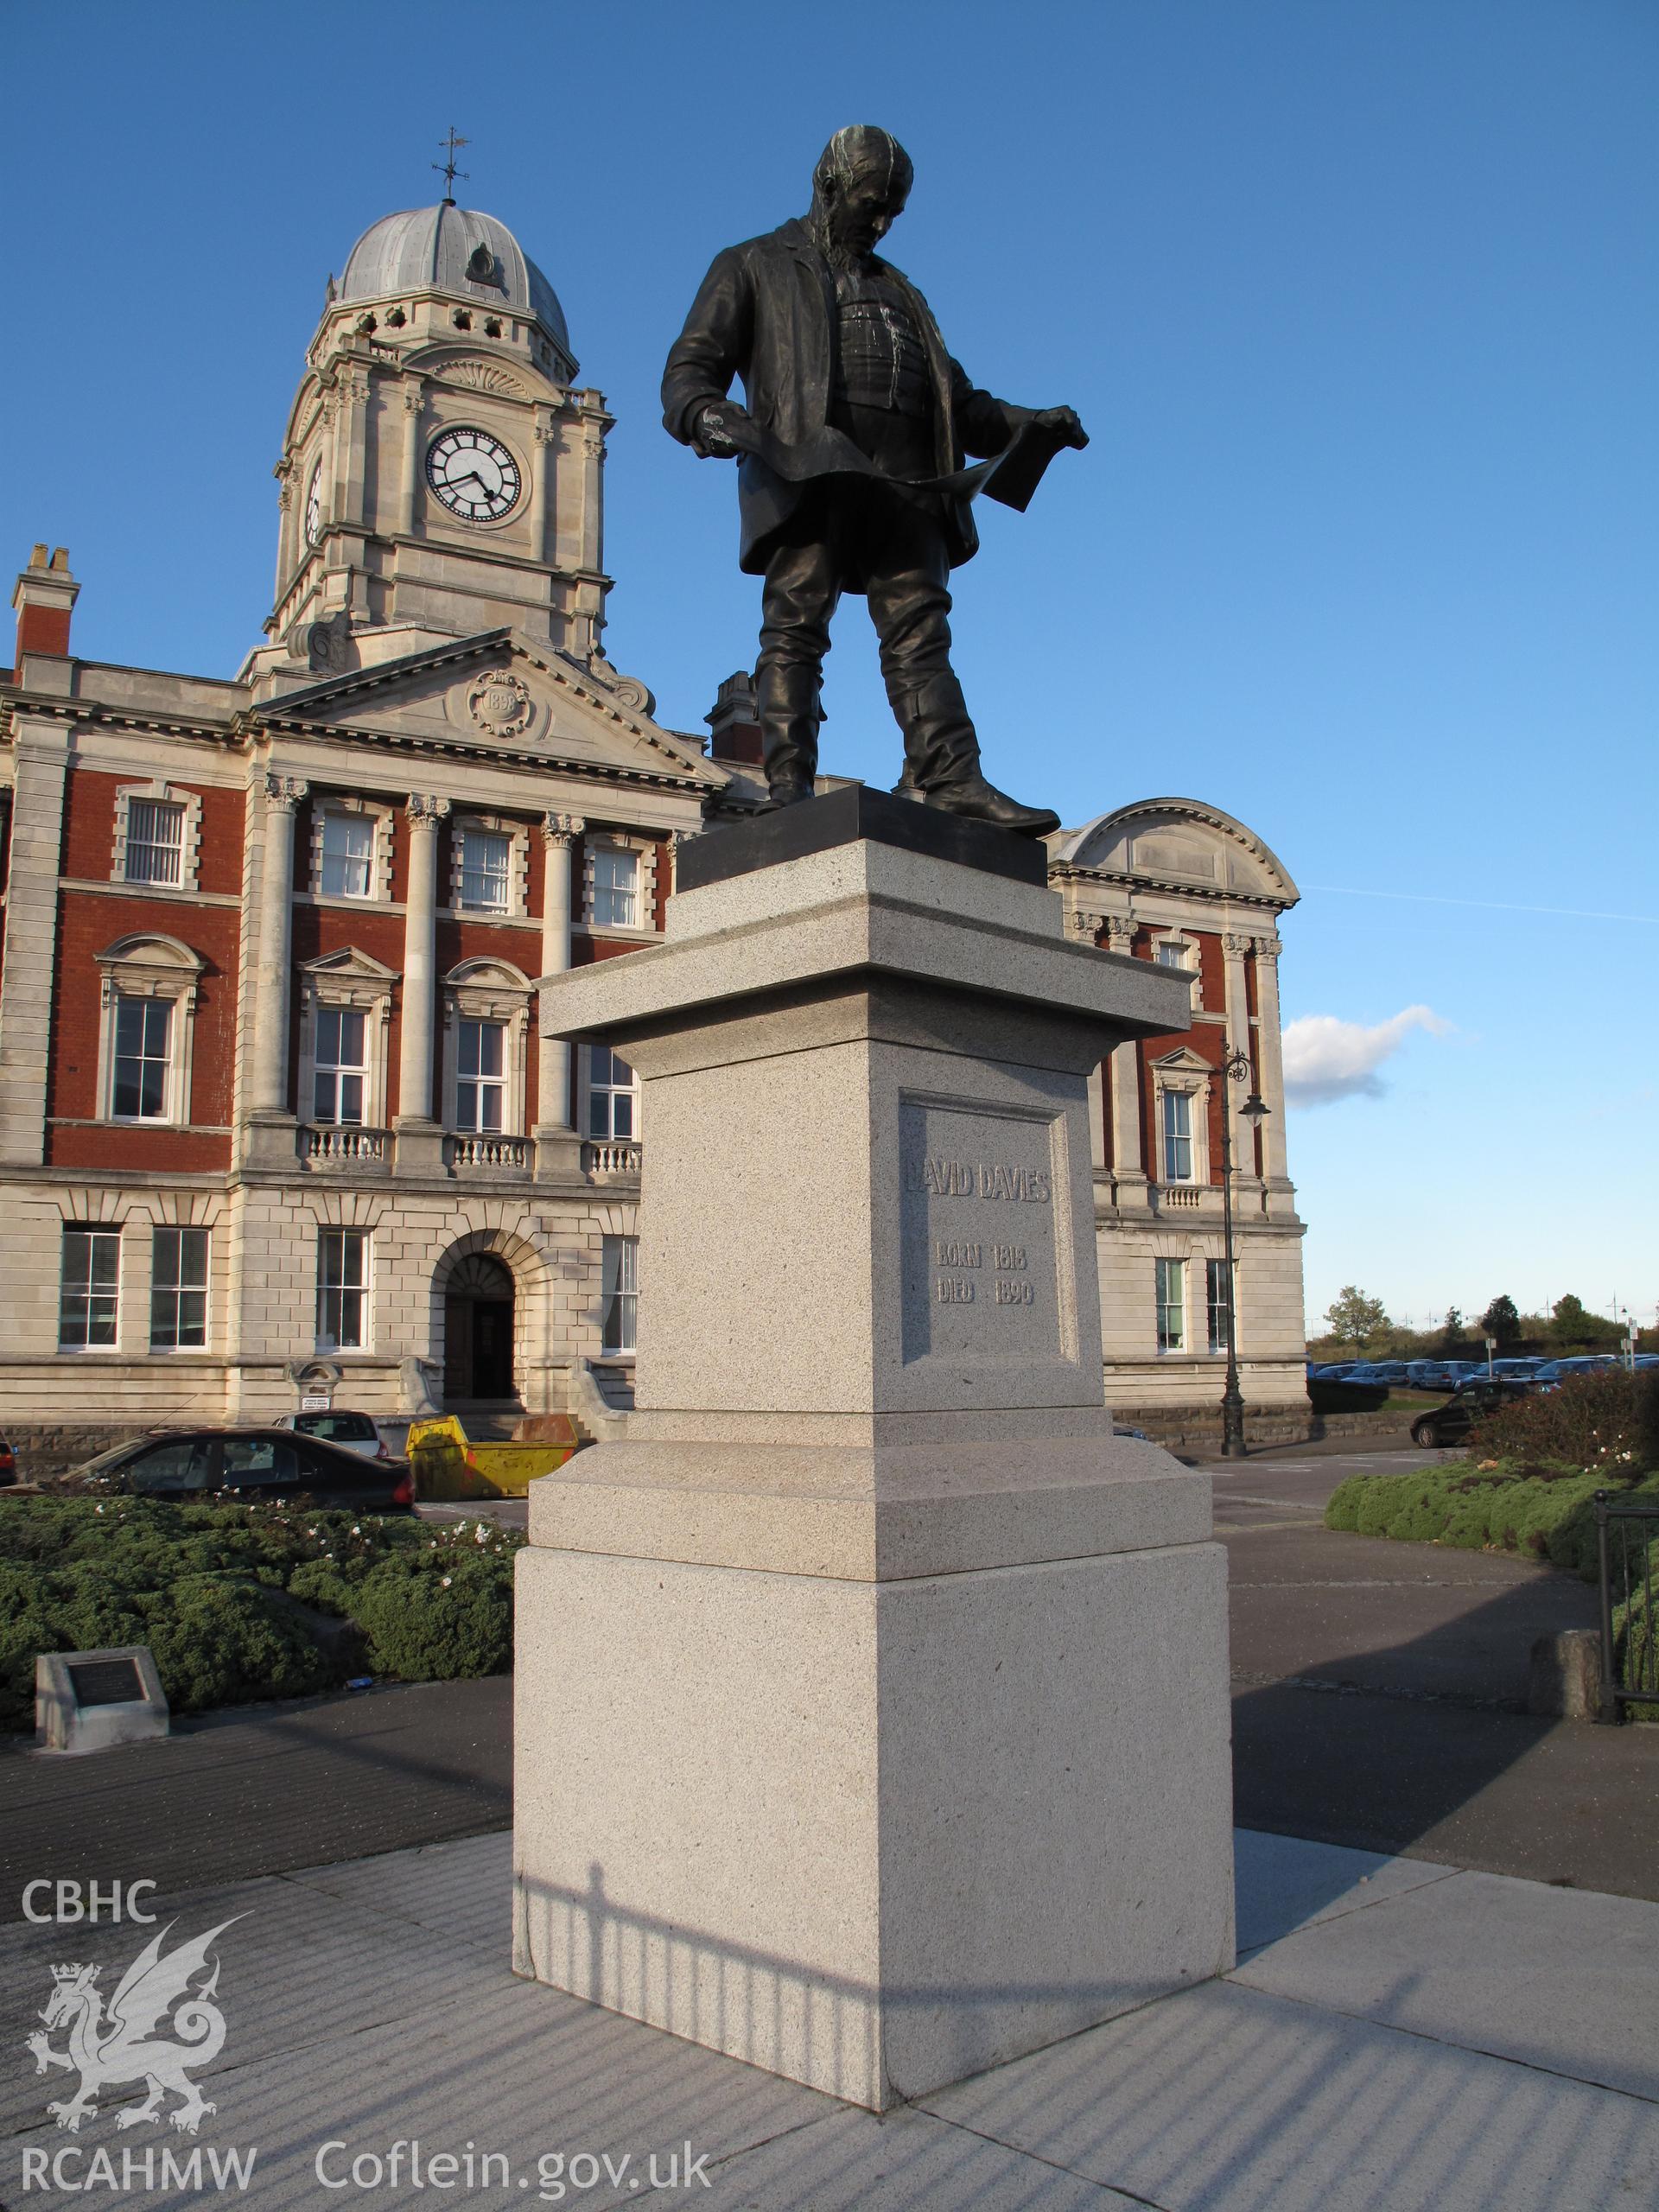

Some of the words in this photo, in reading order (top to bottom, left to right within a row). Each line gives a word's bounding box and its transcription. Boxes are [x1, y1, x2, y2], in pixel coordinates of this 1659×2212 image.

[978, 1164, 1050, 1203] DAVIES
[937, 1242, 982, 1268] BORN
[995, 1243, 1027, 1270] 1818
[938, 1278, 975, 1304] DIED
[995, 1280, 1033, 1305] 1890
